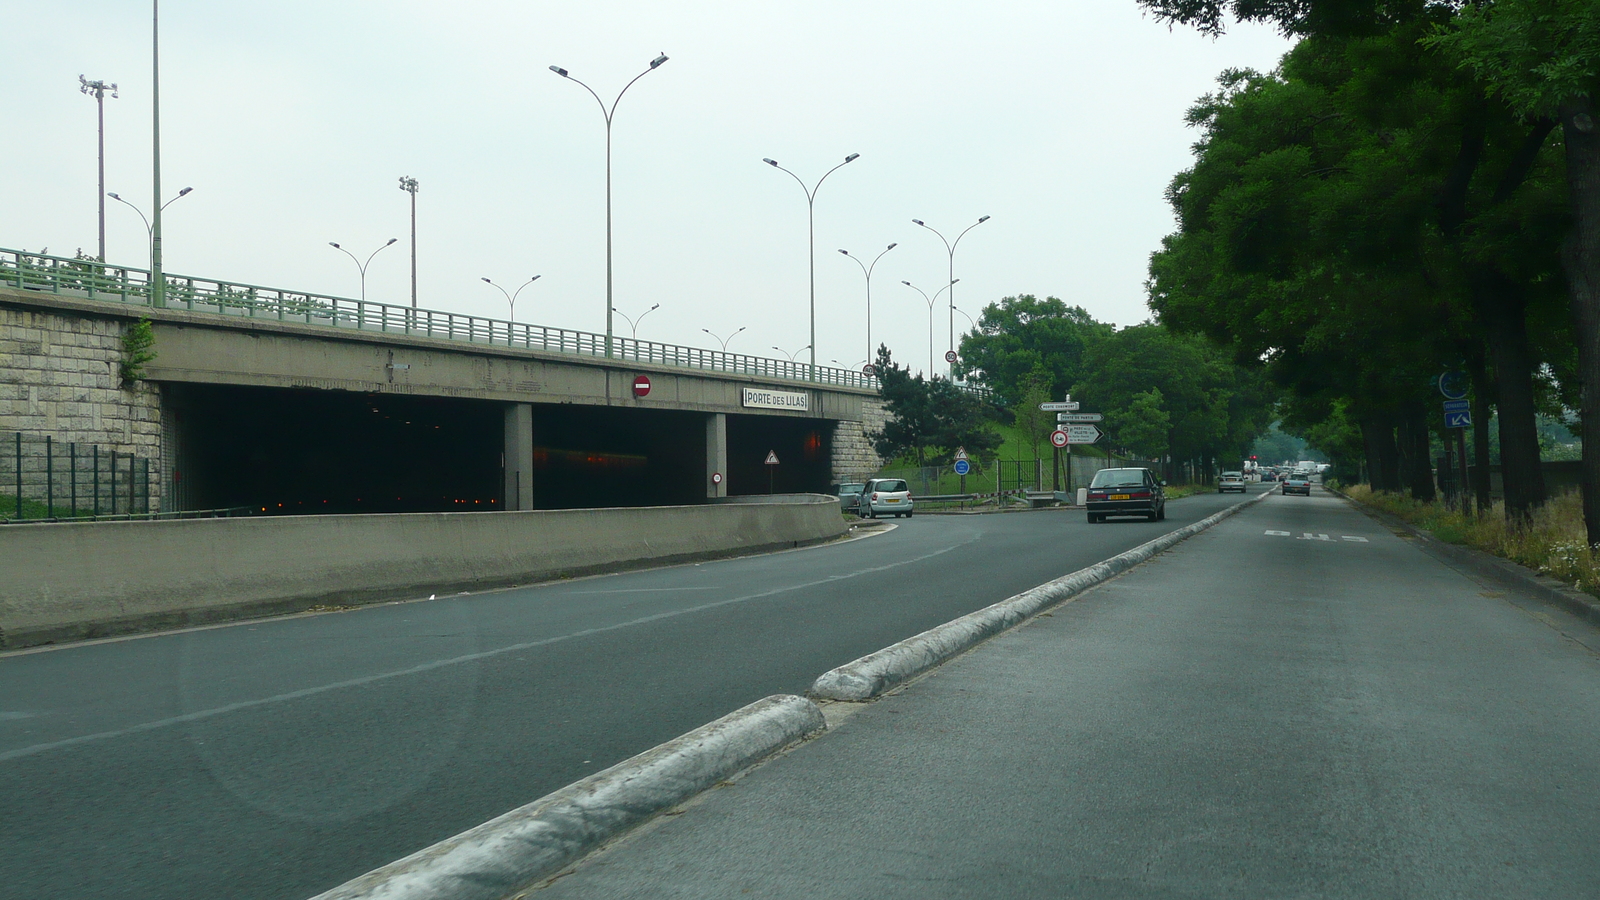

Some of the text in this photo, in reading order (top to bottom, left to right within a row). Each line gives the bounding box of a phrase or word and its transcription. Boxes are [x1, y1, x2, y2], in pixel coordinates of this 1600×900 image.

[748, 392, 805, 407] PORTE DES LILAS
